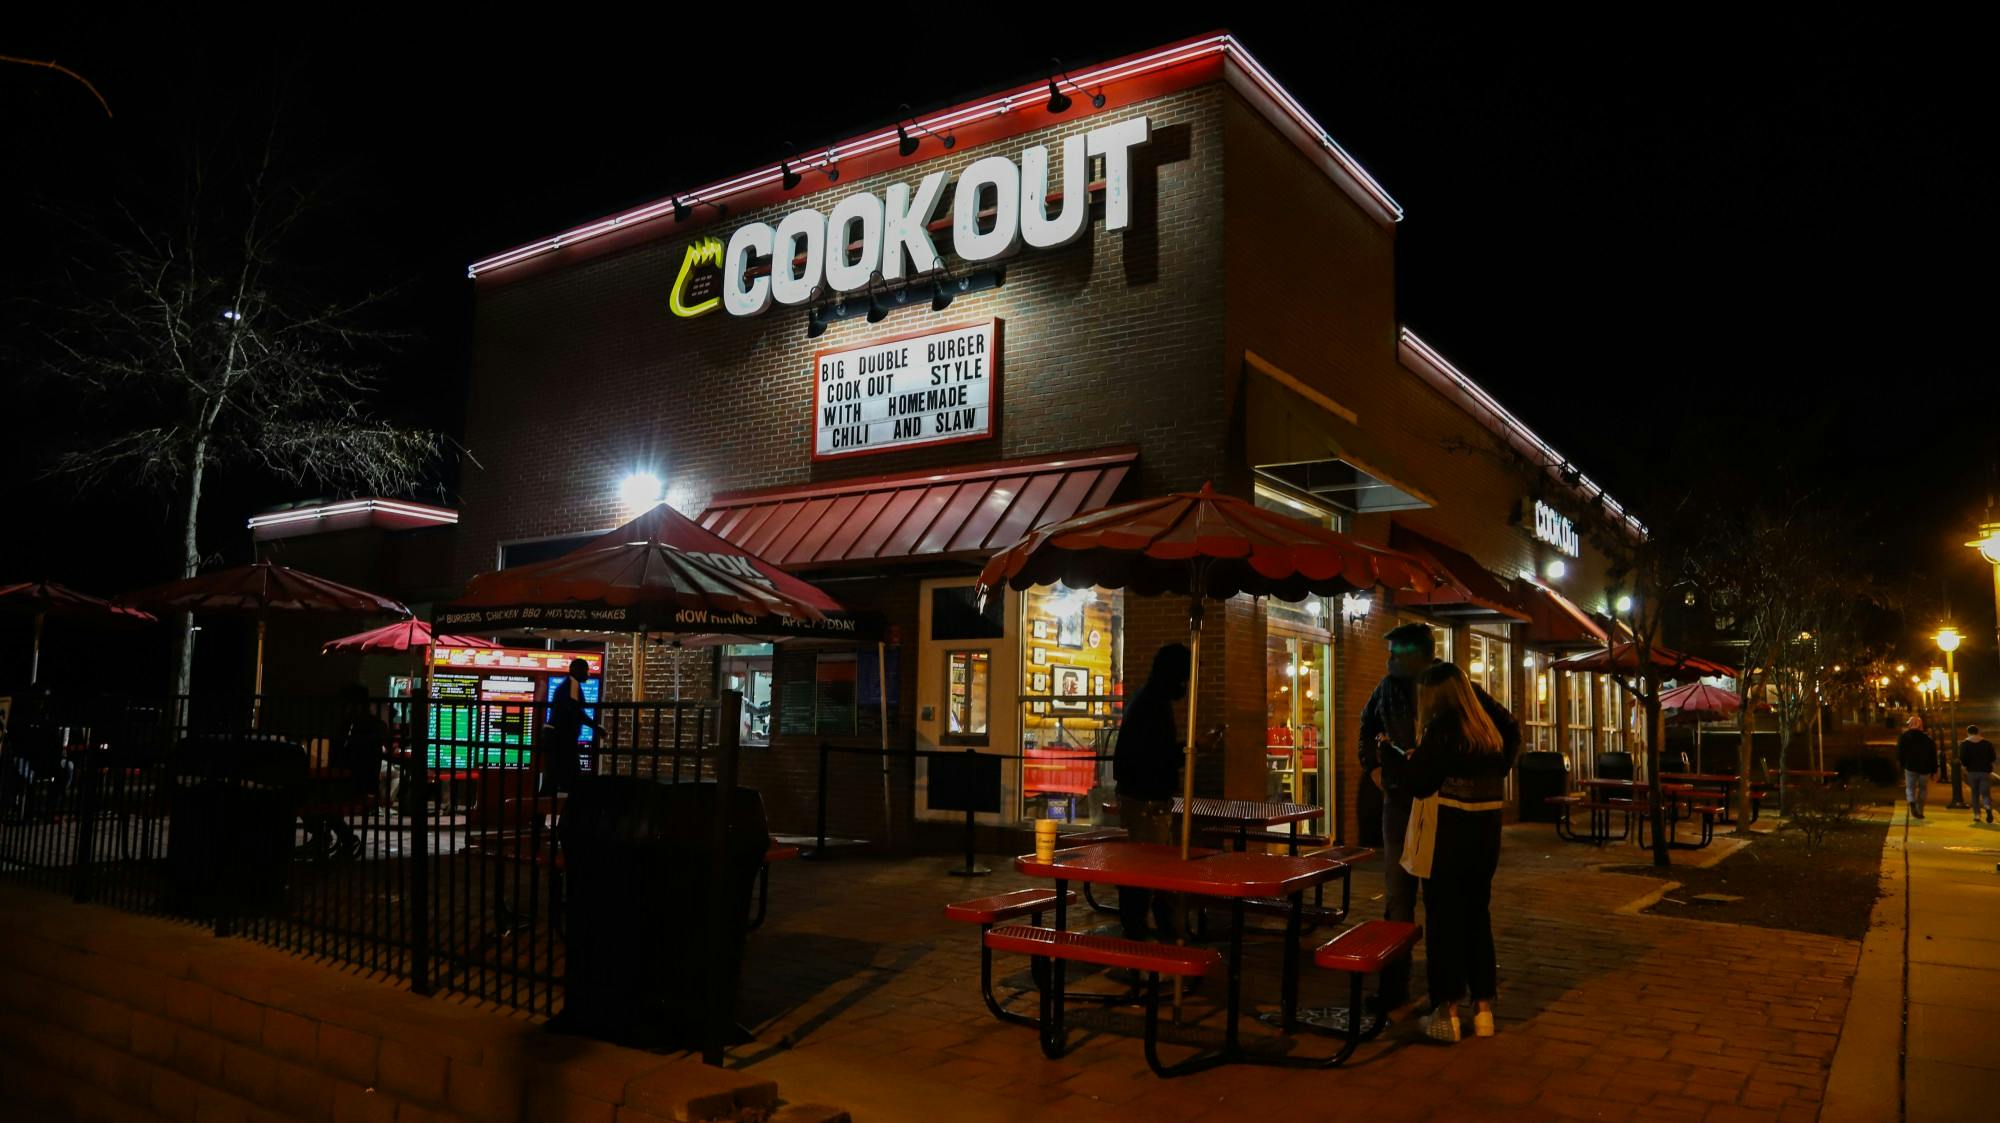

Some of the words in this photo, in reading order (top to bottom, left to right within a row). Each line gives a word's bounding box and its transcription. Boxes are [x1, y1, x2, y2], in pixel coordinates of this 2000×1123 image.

[723, 170, 950, 317] COOK
[953, 116, 1152, 261] OUT
[822, 360, 844, 382] BIG
[928, 334, 985, 363] BURGER
[827, 380, 861, 403] COOK
[867, 374, 894, 397] OUT
[931, 358, 982, 386] STYLE
[824, 402, 861, 427] WITH
[888, 384, 967, 417] HOMEMADE
[832, 424, 868, 448] CHILI
[893, 416, 921, 440] AND
[935, 408, 976, 433] SLAW
[1535, 499, 1563, 549] COOK
[446, 611, 482, 624] BURGERS
[486, 608, 519, 621] CHICKEN
[522, 607, 542, 618] BBQ
[675, 609, 708, 624] NOW
